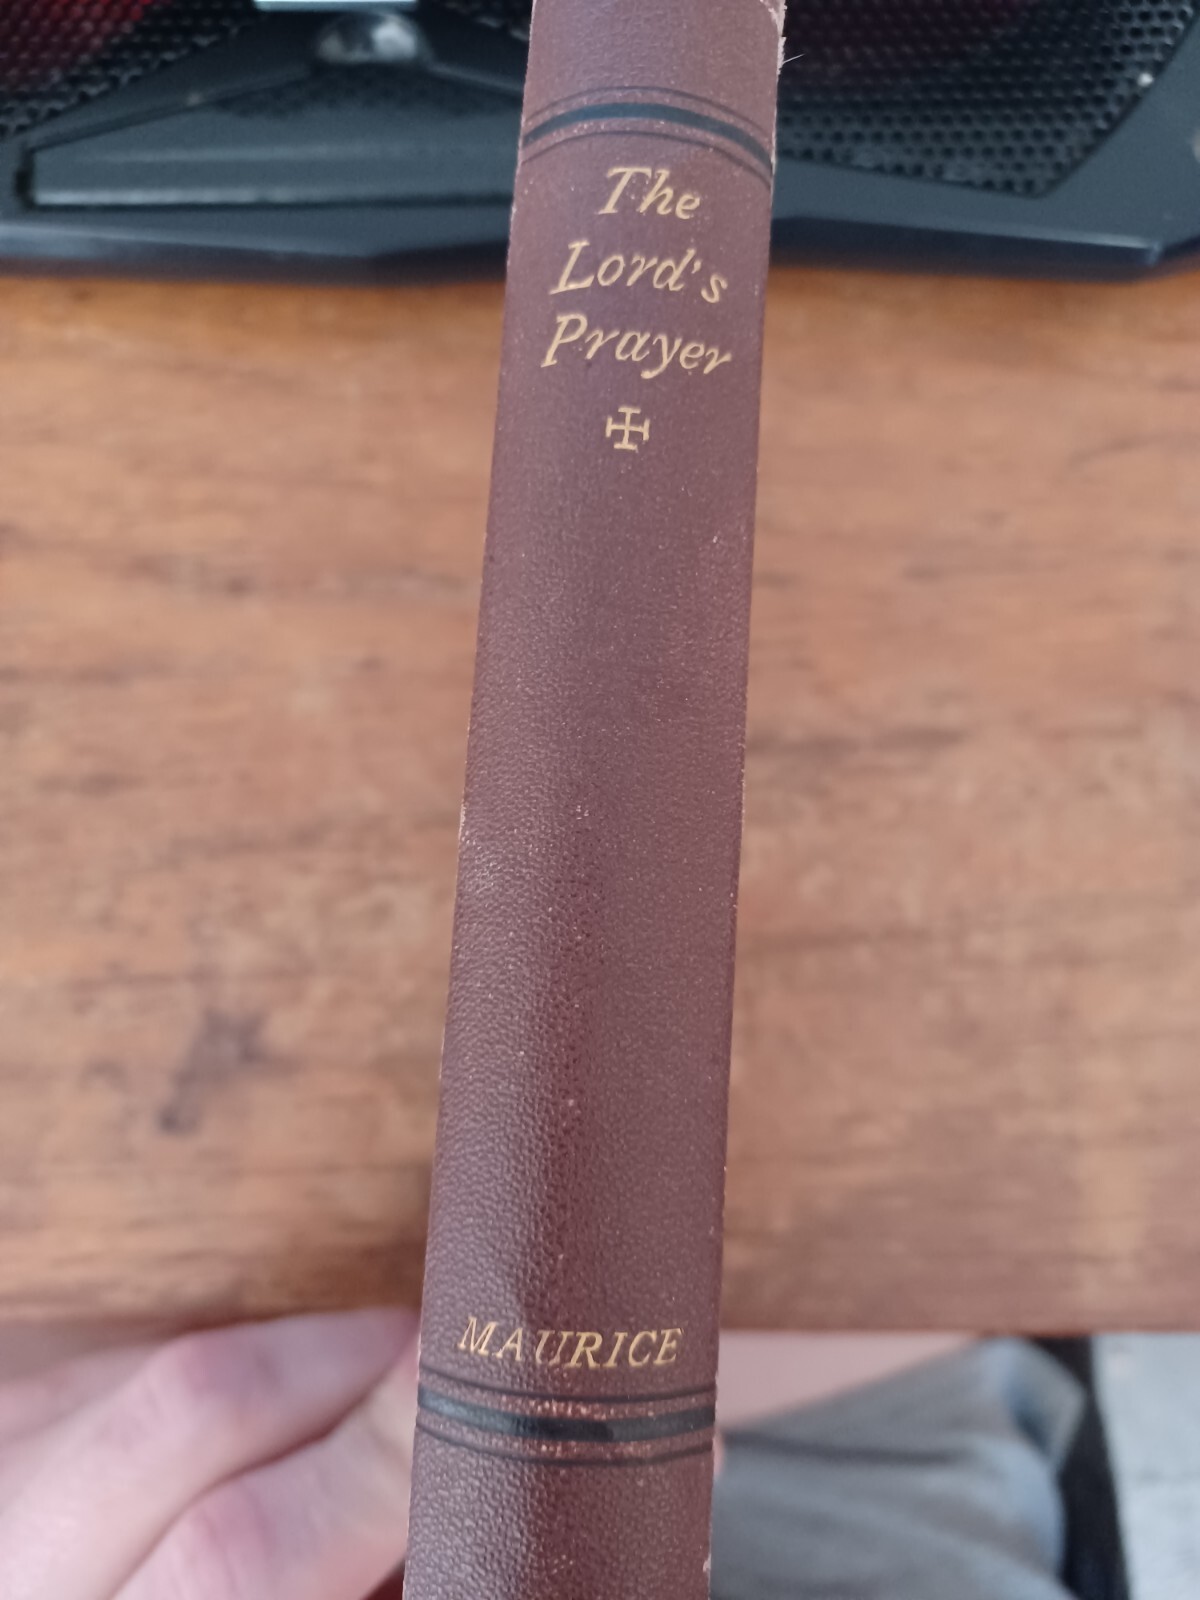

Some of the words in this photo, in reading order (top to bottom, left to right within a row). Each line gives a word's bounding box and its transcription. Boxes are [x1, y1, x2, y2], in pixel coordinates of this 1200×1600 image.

[598, 167, 700, 219] The
[550, 239, 728, 303] Lord's
[540, 313, 732, 379] Prayer
[457, 1316, 684, 1369] MAURICE
